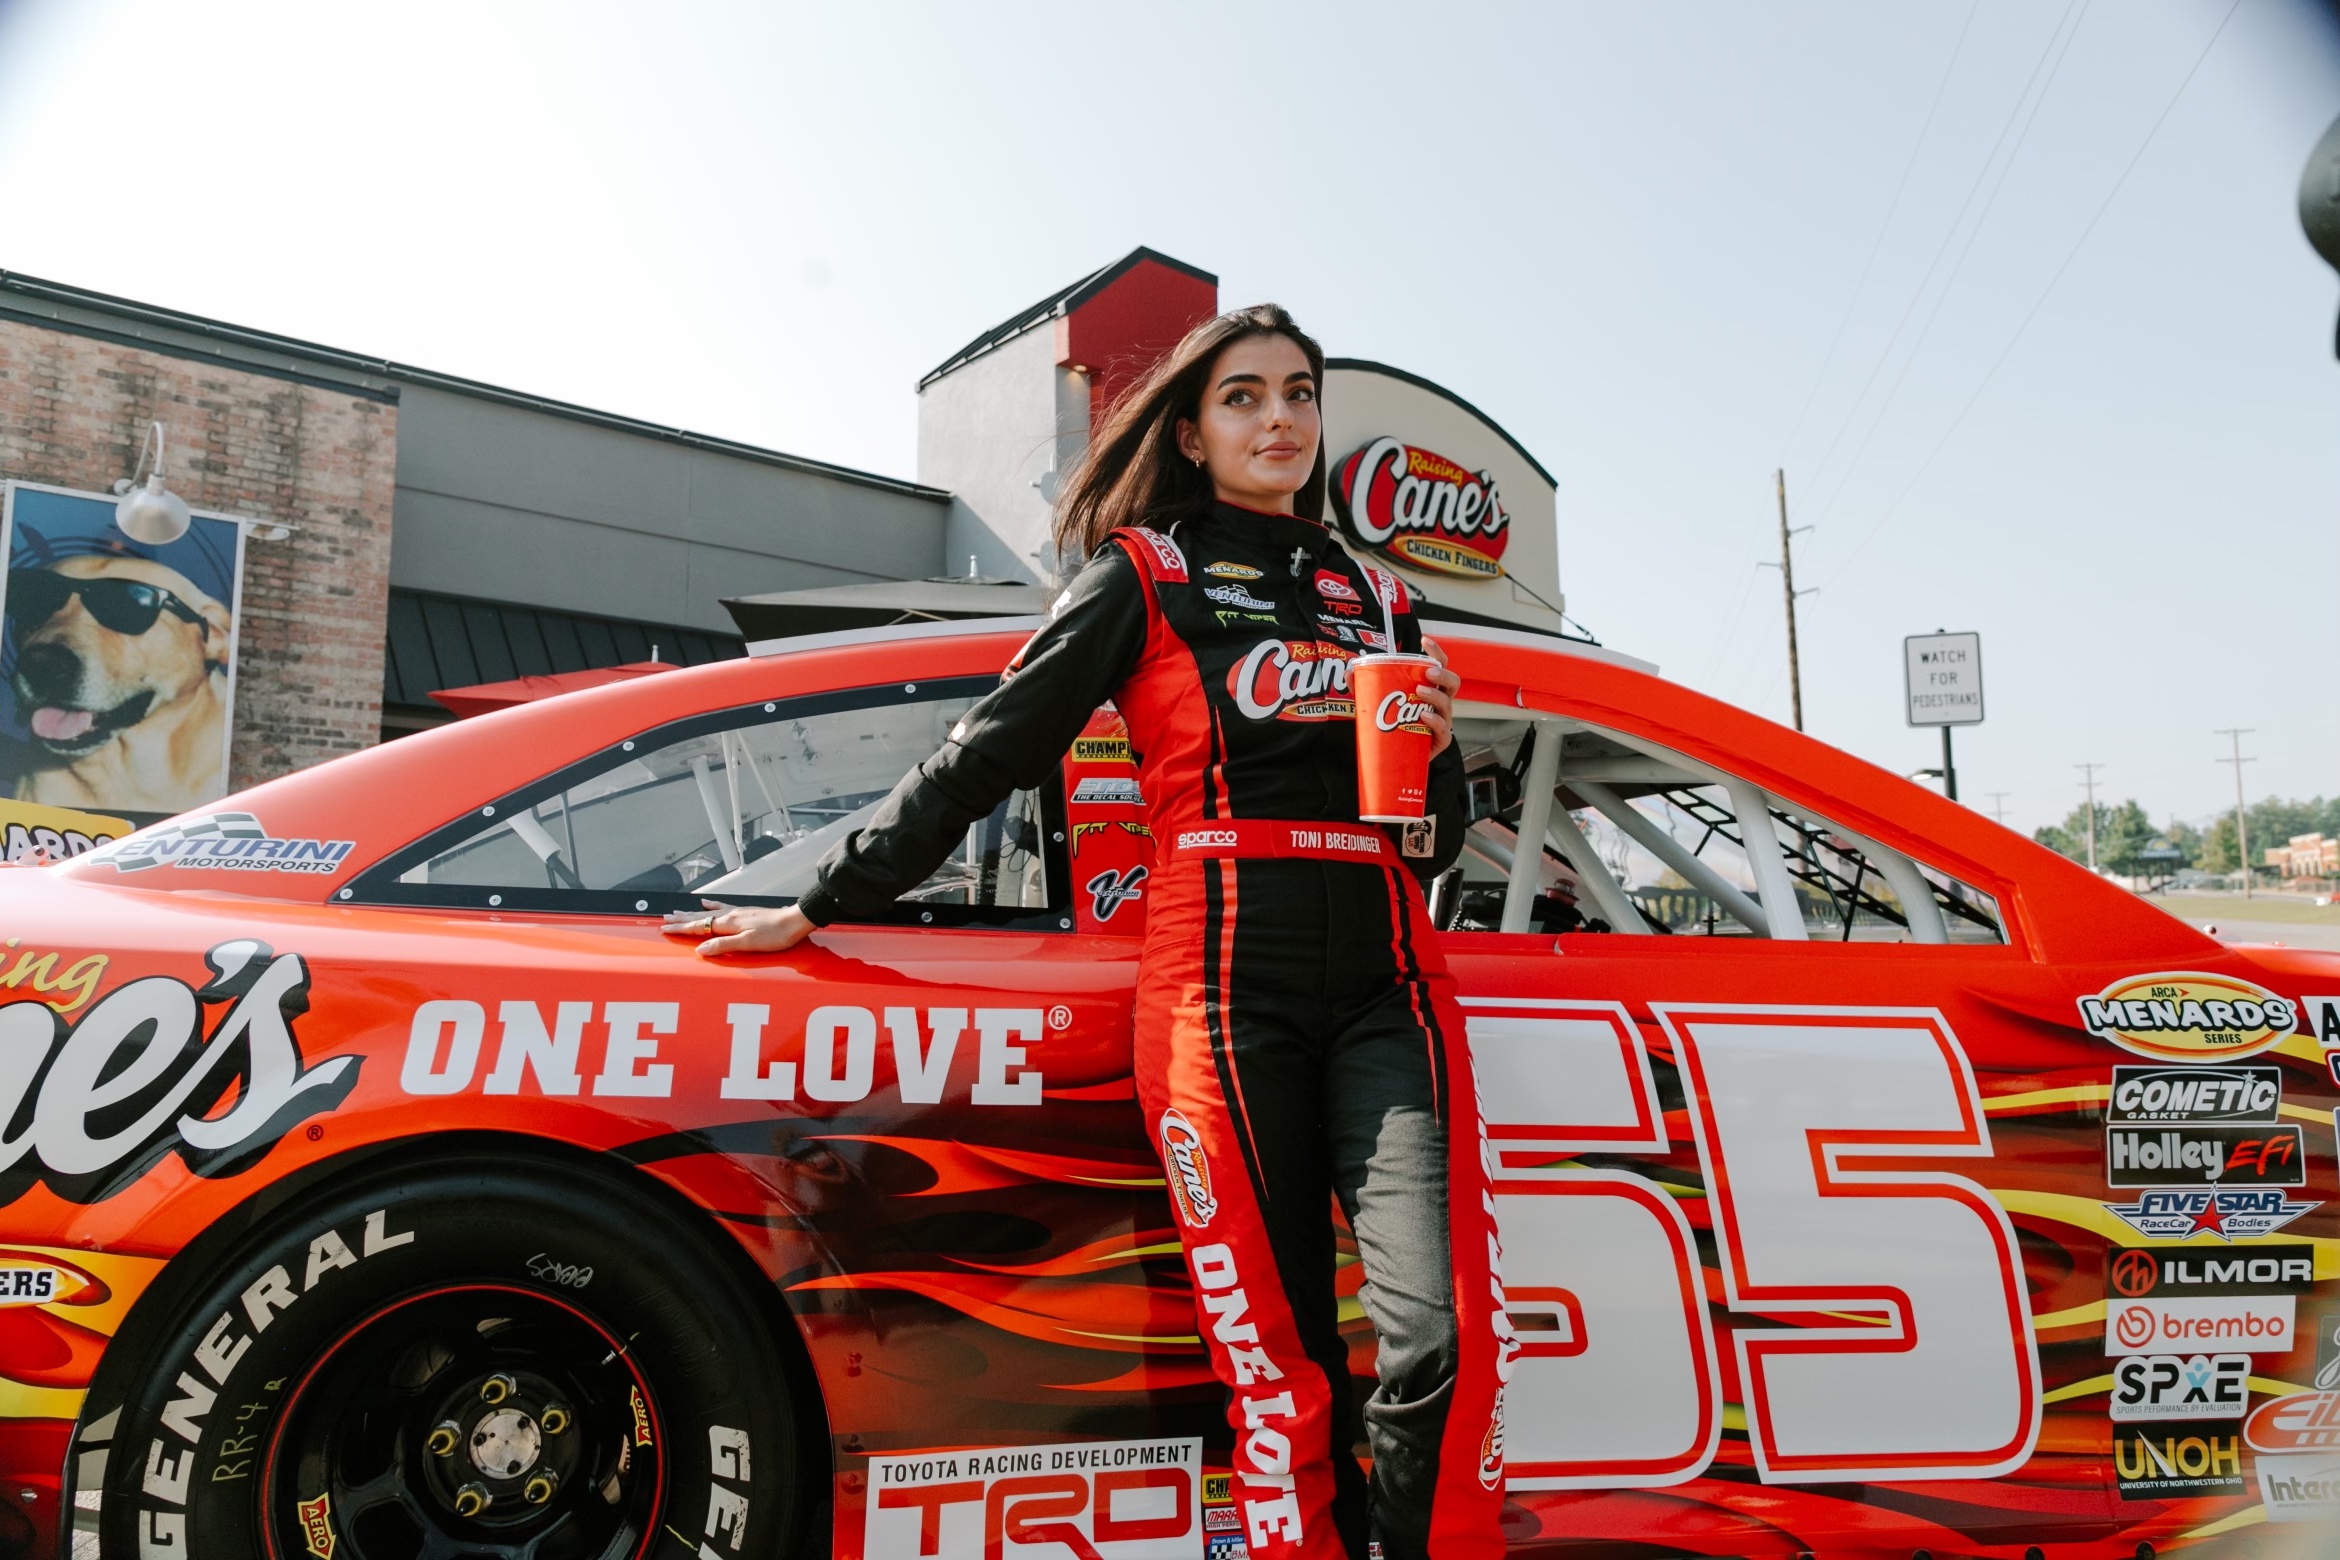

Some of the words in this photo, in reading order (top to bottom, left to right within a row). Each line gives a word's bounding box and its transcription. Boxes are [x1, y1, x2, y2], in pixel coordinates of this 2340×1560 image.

[1409, 451, 1463, 485] Raising
[1351, 436, 1510, 544] Cane's
[1138, 527, 1181, 569] parco
[1406, 538, 1452, 563] CHICKEN
[1455, 552, 1498, 574] FINGERS
[1204, 566, 1264, 577] MENARDS
[1205, 589, 1275, 607] VENTURINI
[1324, 601, 1362, 616] TRD
[1215, 611, 1239, 627] PIT
[1243, 613, 1280, 625] VIPER
[1920, 650, 1966, 664] WATCH
[1236, 639, 1367, 719] Can
[1930, 671, 1958, 686] FOR
[1376, 691, 1434, 731] Can
[1912, 692, 1978, 708] PEDESTRIANS
[0, 823, 115, 861] ARD
[103, 838, 355, 861] ENTURINI
[1073, 822, 1108, 857] PIT
[1177, 830, 1237, 849] sparco
[1290, 831, 1322, 848] TONI
[1325, 832, 1381, 854] BREIDINGER
[178, 857, 336, 873] MOTORSPORTS
[2151, 987, 2178, 998] ARCA
[2082, 999, 2293, 1032] MENARDS
[400, 1000, 680, 1097] ONE
[720, 1003, 1045, 1106] LOVE
[2204, 1033, 2243, 1044] SERIES
[2116, 1078, 2277, 1112] COMETIC
[2127, 1112, 2190, 1120] GASKET
[1161, 1116, 1217, 1225] Cane's
[2112, 1133, 2224, 1180] Holley
[2225, 1135, 2295, 1176] EFI
[2142, 1193, 2210, 1214] FIVE
[2216, 1193, 2283, 1214] STAR
[2140, 1219, 2191, 1229] RaceCar
[2228, 1218, 2271, 1228] Bodies
[2164, 1259, 2312, 1284] ILMOR
[1192, 1243, 1283, 1385] ONE
[2163, 1312, 2285, 1339] brembo
[138, 1209, 415, 1560] GENERAL
[635, 1396, 651, 1439] AERO
[2116, 1405, 2143, 1414] SPORTS
[2190, 1404, 2199, 1412] BY
[2201, 1403, 2241, 1412] EVALUATION
[881, 1461, 959, 1483] TOYOTA
[968, 1453, 1042, 1476] RACING
[1051, 1445, 1192, 1471] DEVELOPMENT
[2114, 1433, 2241, 1479] UNOH
[2120, 1481, 2159, 1490] UNIVERSITY
[2169, 1478, 2225, 1487] NORTHWESTERN
[2226, 1477, 2243, 1485] OHIO
[307, 1506, 329, 1549] AERO
[878, 1468, 1192, 1560] TRD
